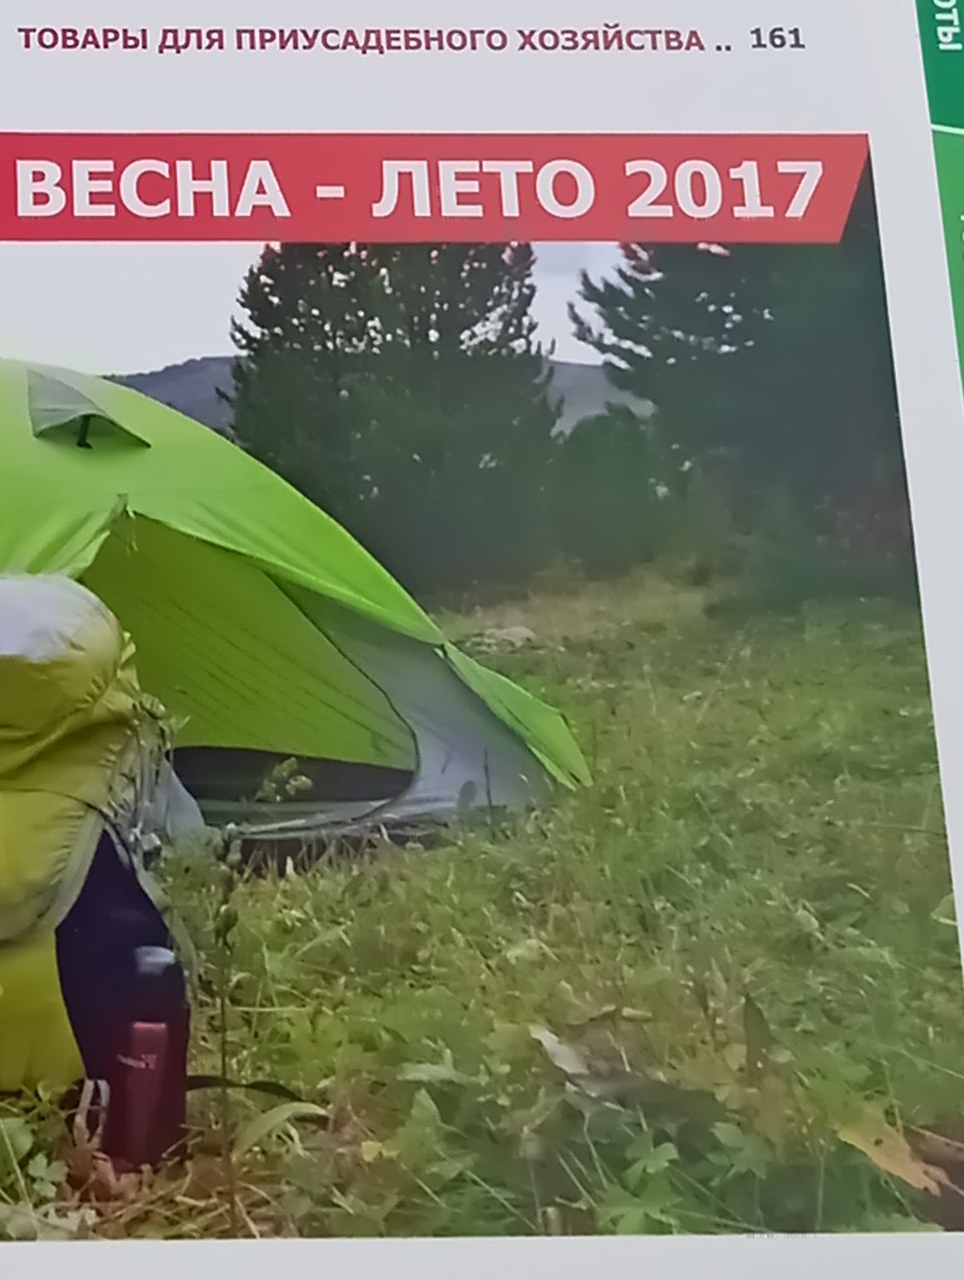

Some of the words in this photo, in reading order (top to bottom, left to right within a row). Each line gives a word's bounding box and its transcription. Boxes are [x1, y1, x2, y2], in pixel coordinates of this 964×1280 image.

[16, 27, 148, 50] ТОВАРЫ
[157, 28, 225, 55] ДЛЯ
[235, 28, 508, 56] ПРИУСАДЕБНОГО
[516, 29, 706, 52] ХОЗЯЙСТВА
[749, 26, 806, 50] 161
[14, 160, 291, 219] ВЕСНА
[371, 160, 597, 219] ЛЕТО
[625, 159, 825, 219] 2017
